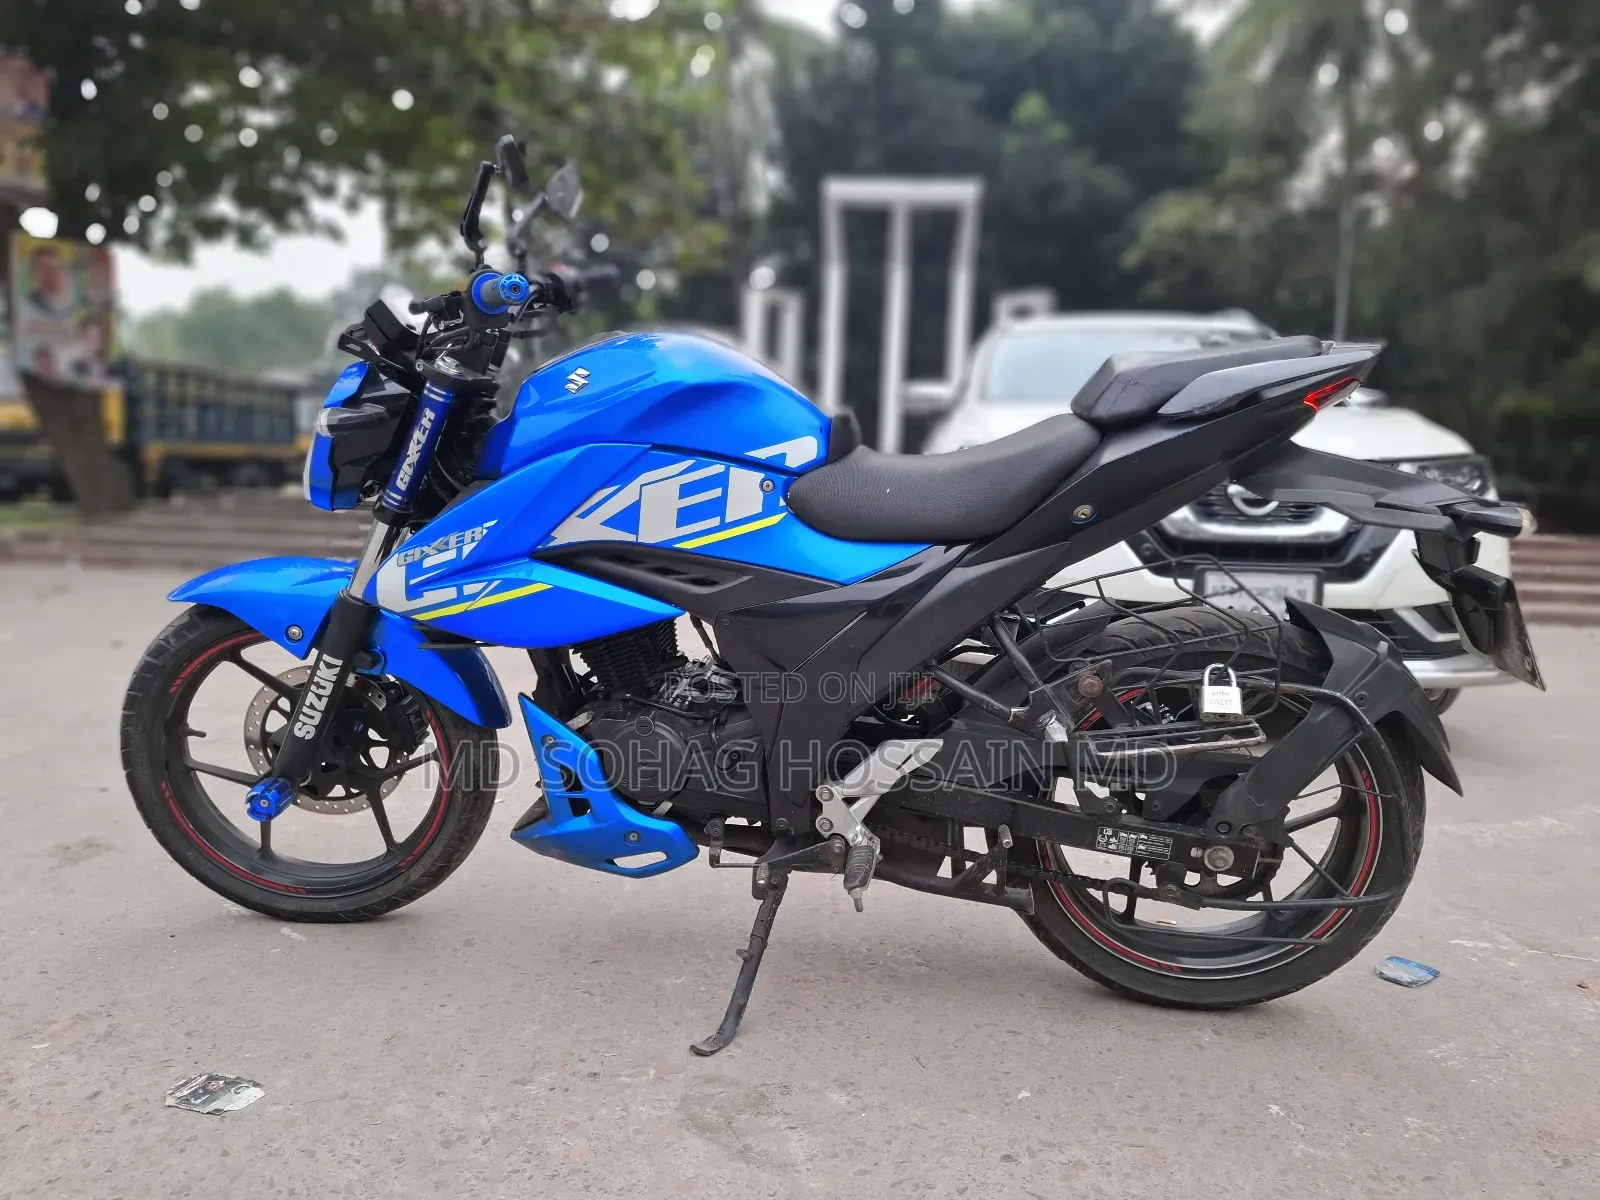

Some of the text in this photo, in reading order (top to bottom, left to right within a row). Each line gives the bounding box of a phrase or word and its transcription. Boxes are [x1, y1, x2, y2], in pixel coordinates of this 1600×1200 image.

[396, 407, 436, 492] GIXXER
[397, 526, 484, 567] GIXXER
[293, 653, 344, 740] SUZUKI
